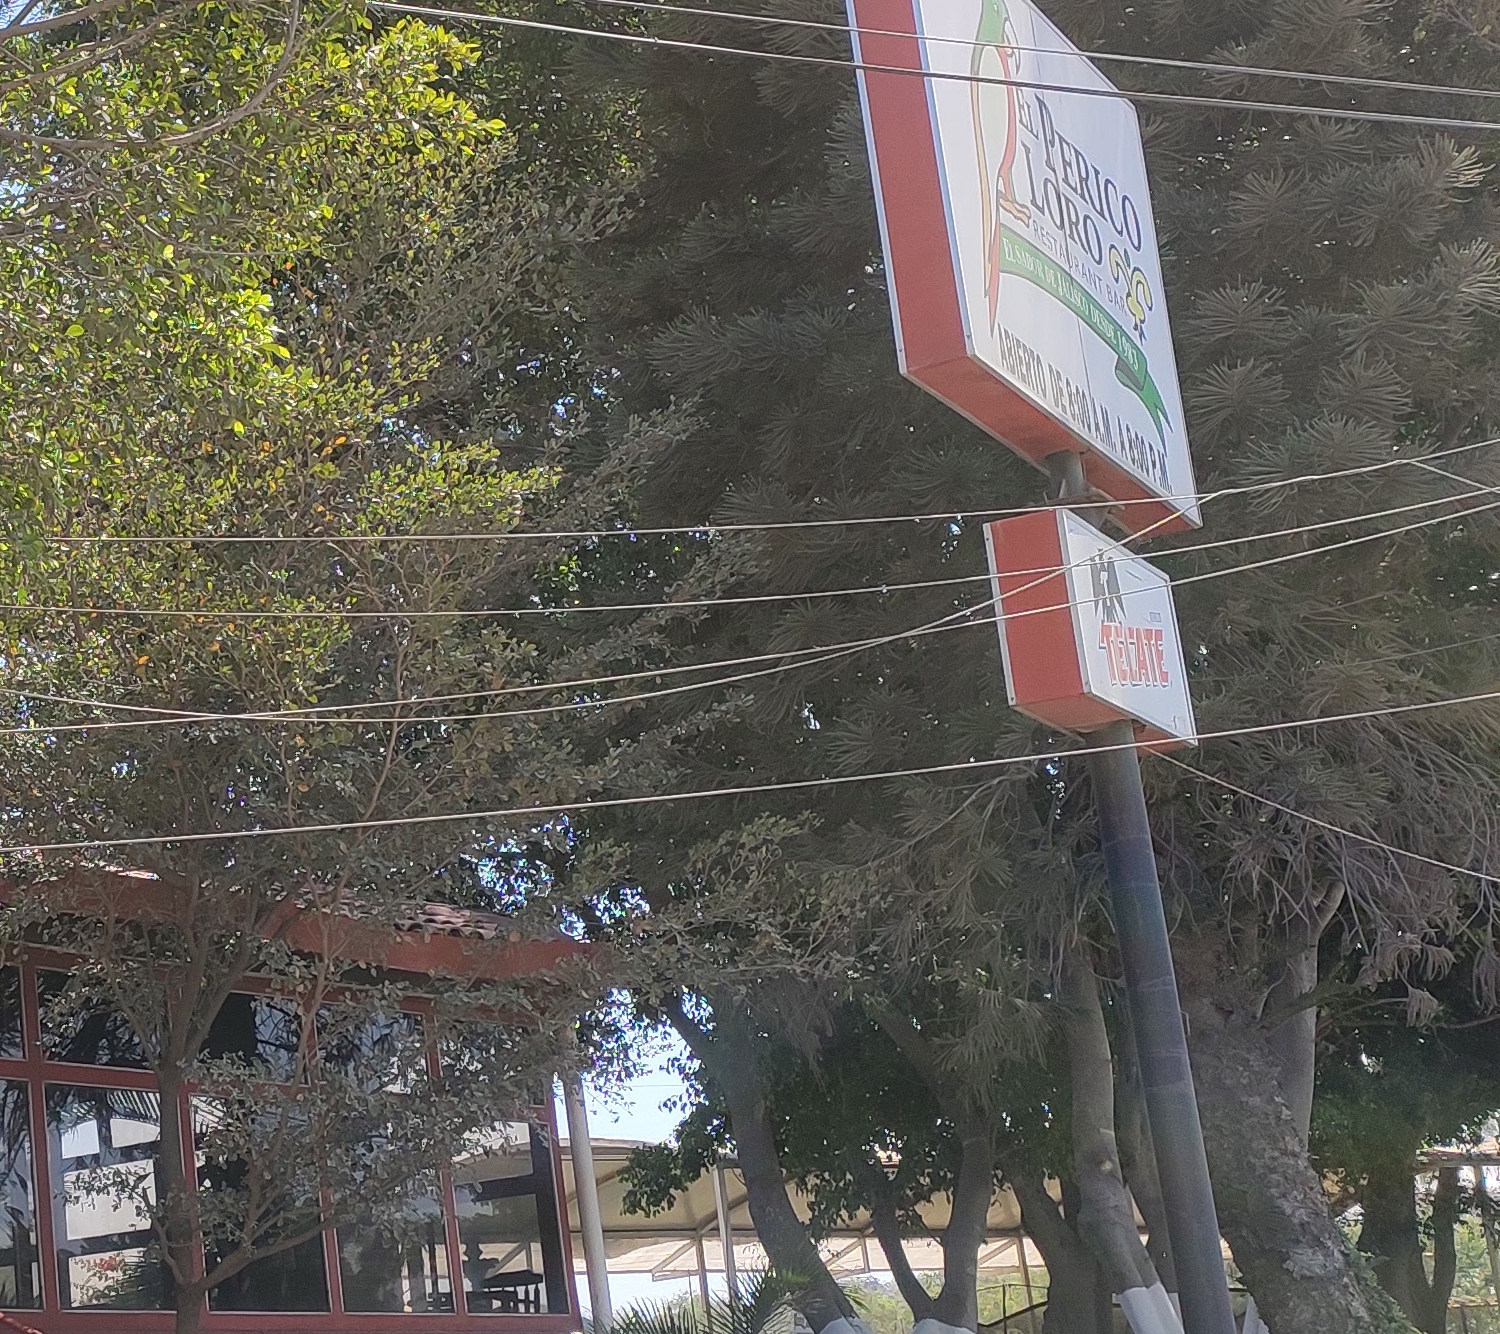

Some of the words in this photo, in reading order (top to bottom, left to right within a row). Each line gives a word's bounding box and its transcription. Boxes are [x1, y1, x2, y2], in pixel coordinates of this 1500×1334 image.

[1016, 88, 1039, 140] EL
[1034, 93, 1141, 252] PERICO
[1021, 140, 1102, 265] LORO
[1002, 236, 1016, 264] EL
[1014, 244, 1045, 281] SABOR
[1044, 264, 1057, 288] DE
[1056, 270, 1089, 316] JALISCO
[1090, 302, 1117, 345] DESDE
[1032, 219, 1103, 295] RESTAURANT
[1106, 283, 1128, 317] BAR
[997, 322, 1047, 400] ABIERTO
[1047, 361, 1067, 416] DE
[1066, 376, 1092, 435] 8:00
[1117, 414, 1129, 461] A
[1099, 622, 1170, 687] TECATE
